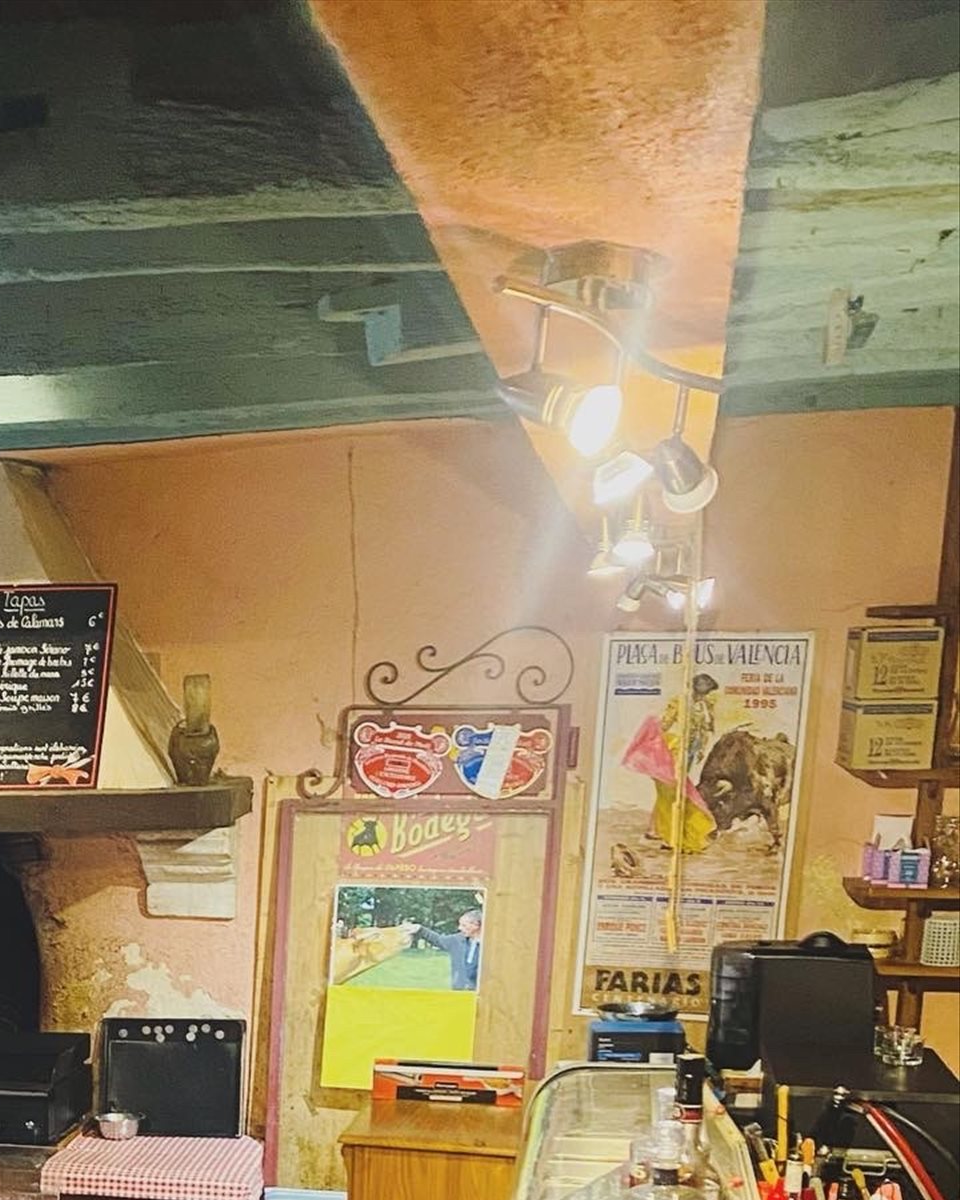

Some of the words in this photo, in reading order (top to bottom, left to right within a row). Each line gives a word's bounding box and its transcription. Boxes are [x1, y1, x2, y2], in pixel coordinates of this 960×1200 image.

[3, 591, 46, 616] Tapas
[6, 618, 19, 629] de
[727, 644, 801, 666] VALENCIA
[763, 673, 773, 683] DE
[873, 664, 888, 685] 12
[744, 698, 778, 710] 1995
[868, 736, 884, 757] 12
[594, 969, 701, 997] FARIAS
